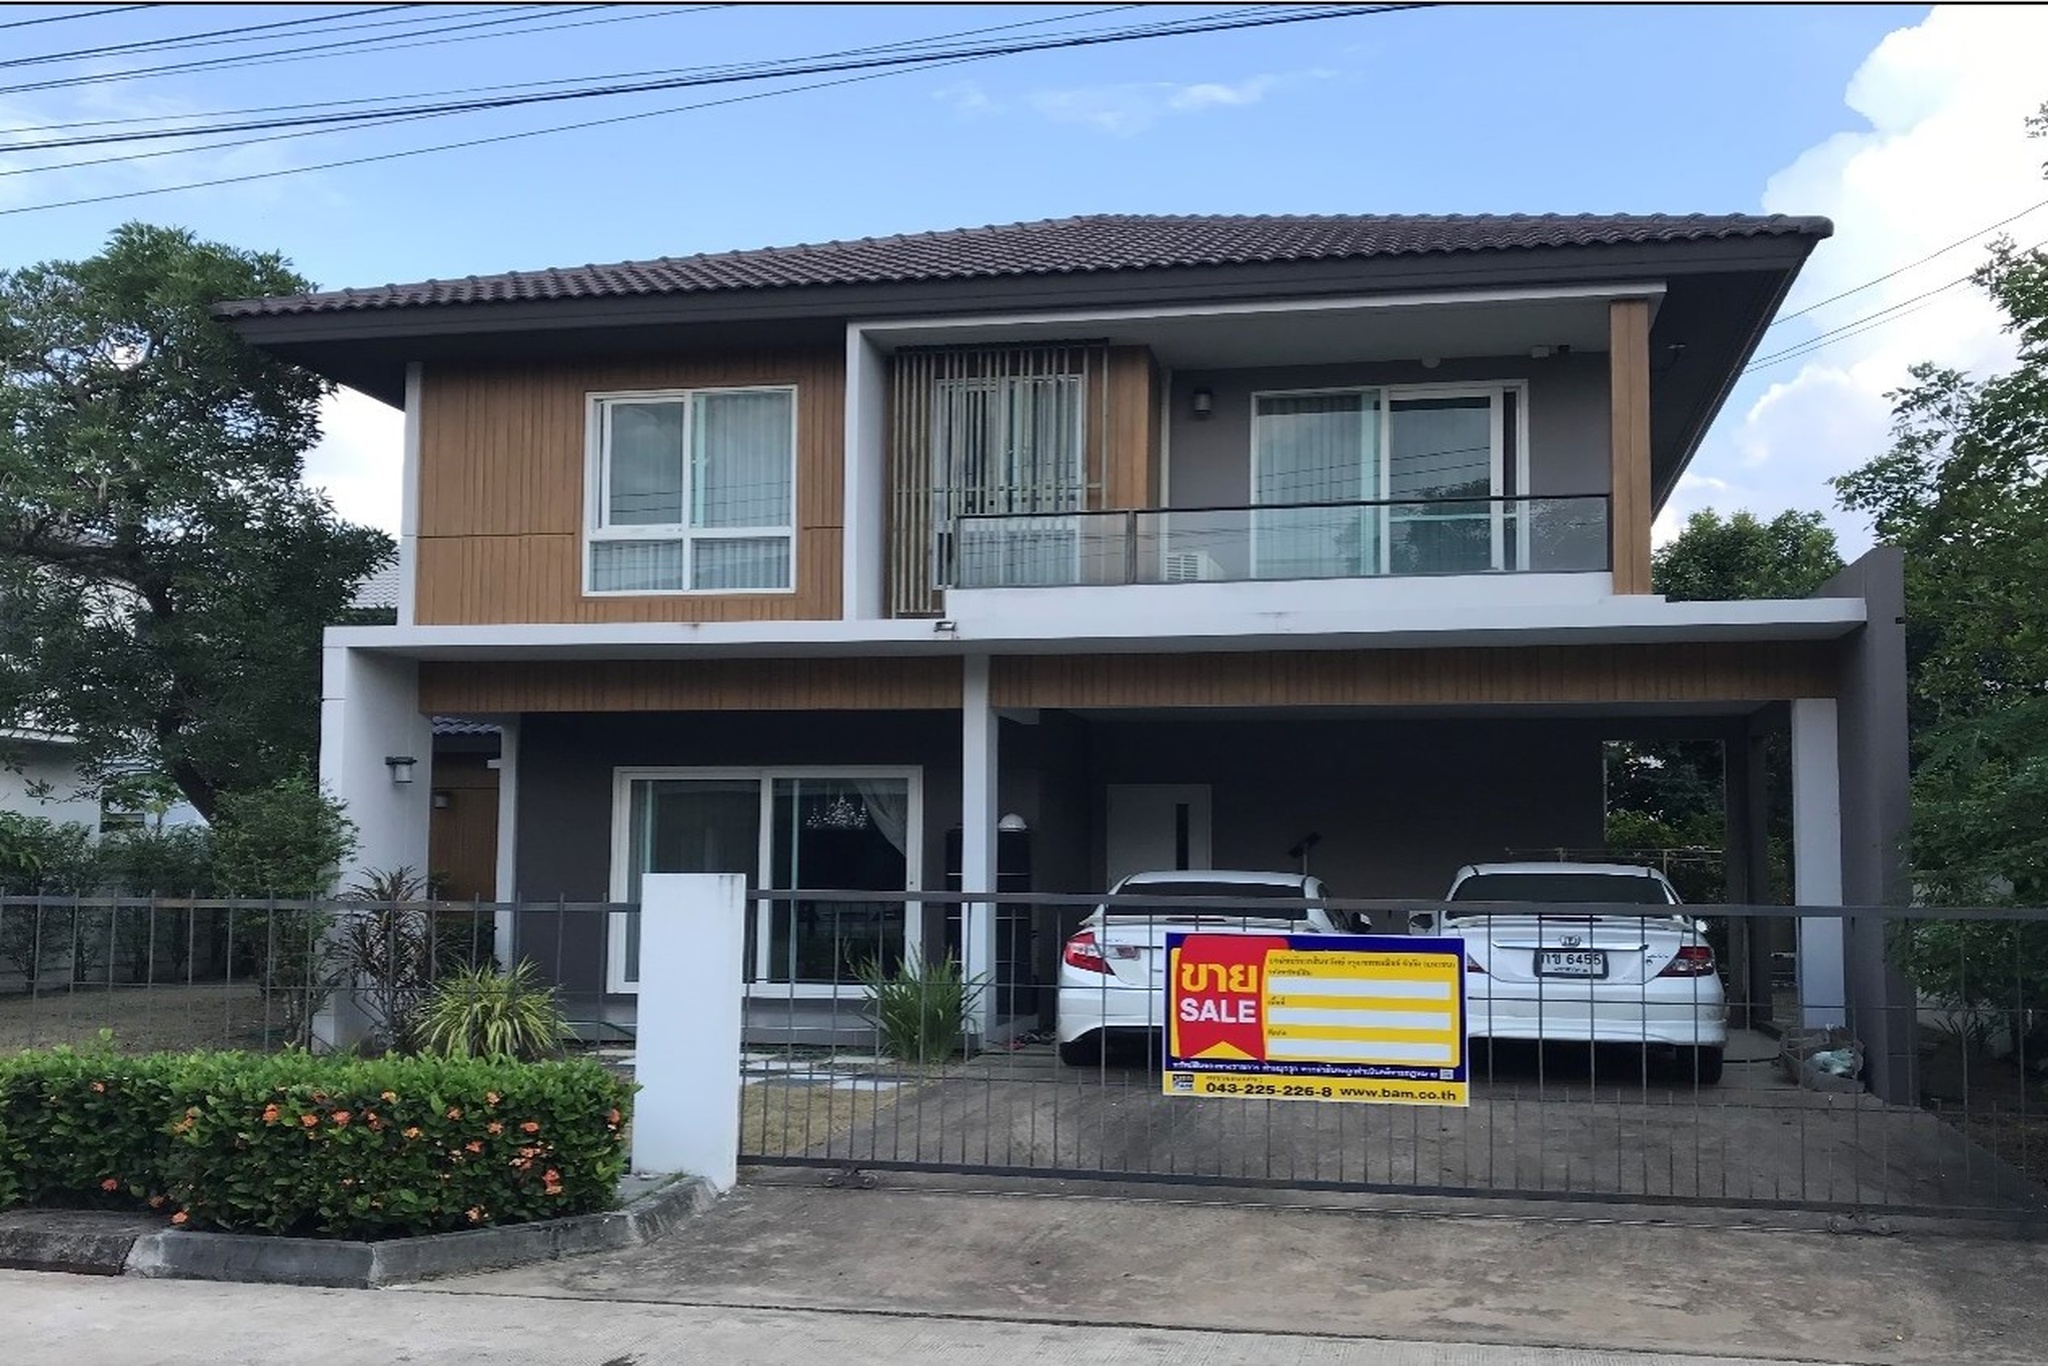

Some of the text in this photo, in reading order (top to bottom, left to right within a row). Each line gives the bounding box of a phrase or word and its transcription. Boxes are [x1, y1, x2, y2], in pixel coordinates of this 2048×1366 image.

[1566, 953, 1602, 966] 6455
[1181, 962, 1258, 993] ขาย
[1180, 997, 1257, 1024] SALE
[1206, 1082, 1333, 1098] 043-225-226-8
[1340, 1087, 1457, 1101] www.bam.co.th
